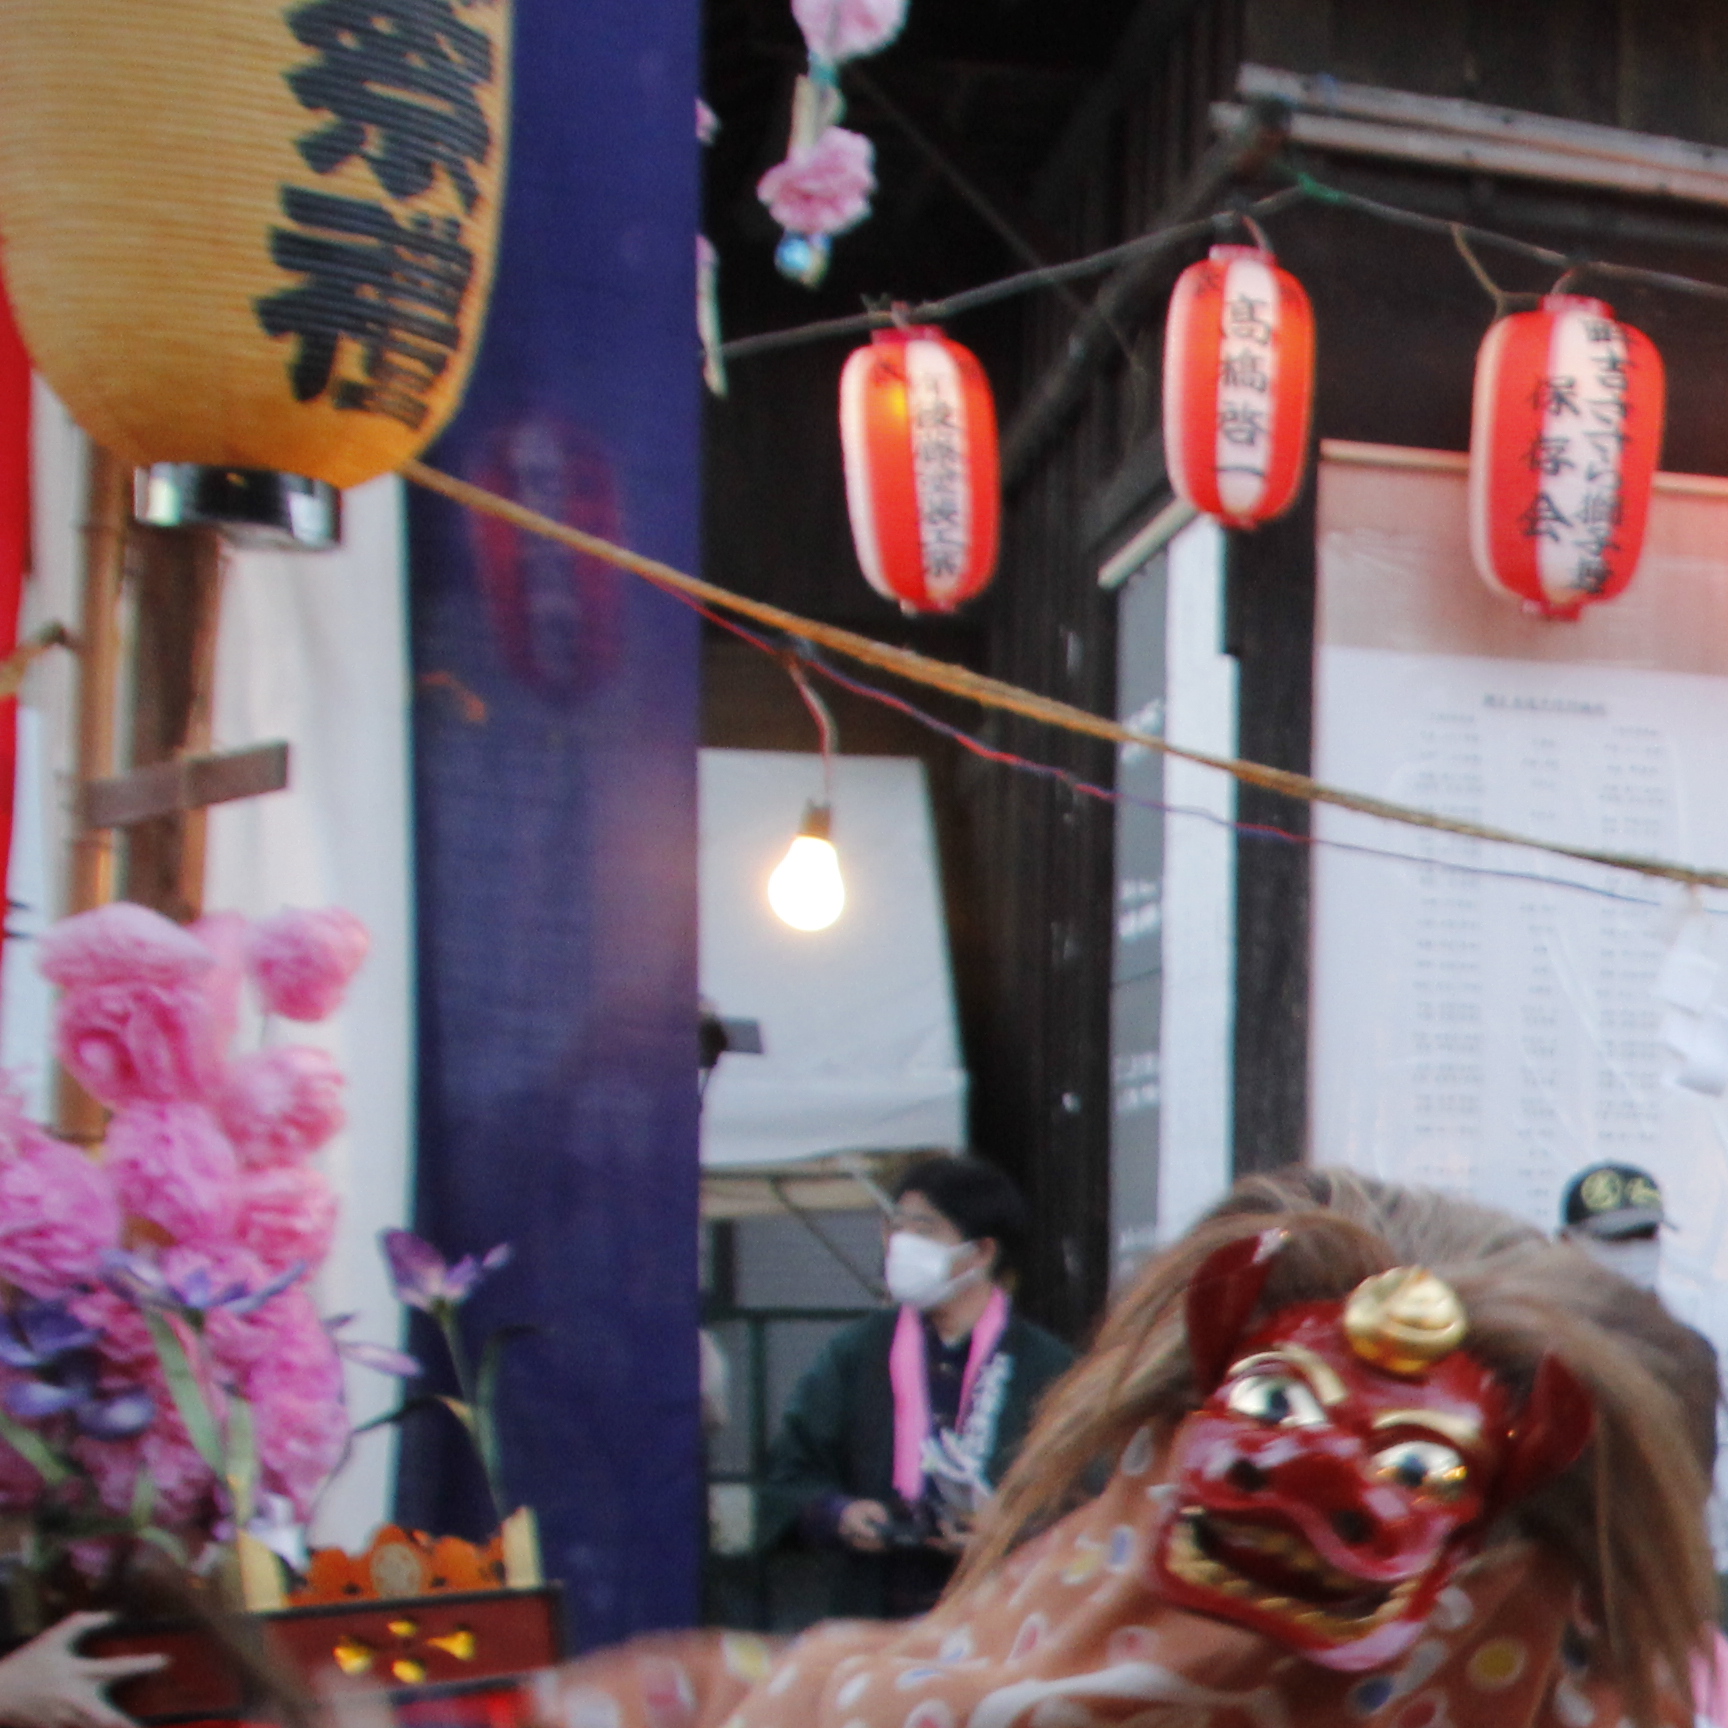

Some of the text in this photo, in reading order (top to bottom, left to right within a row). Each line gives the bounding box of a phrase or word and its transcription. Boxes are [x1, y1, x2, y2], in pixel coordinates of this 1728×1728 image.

[252, 0, 500, 430] 祭禮
[1516, 375, 1581, 543] 保存会
